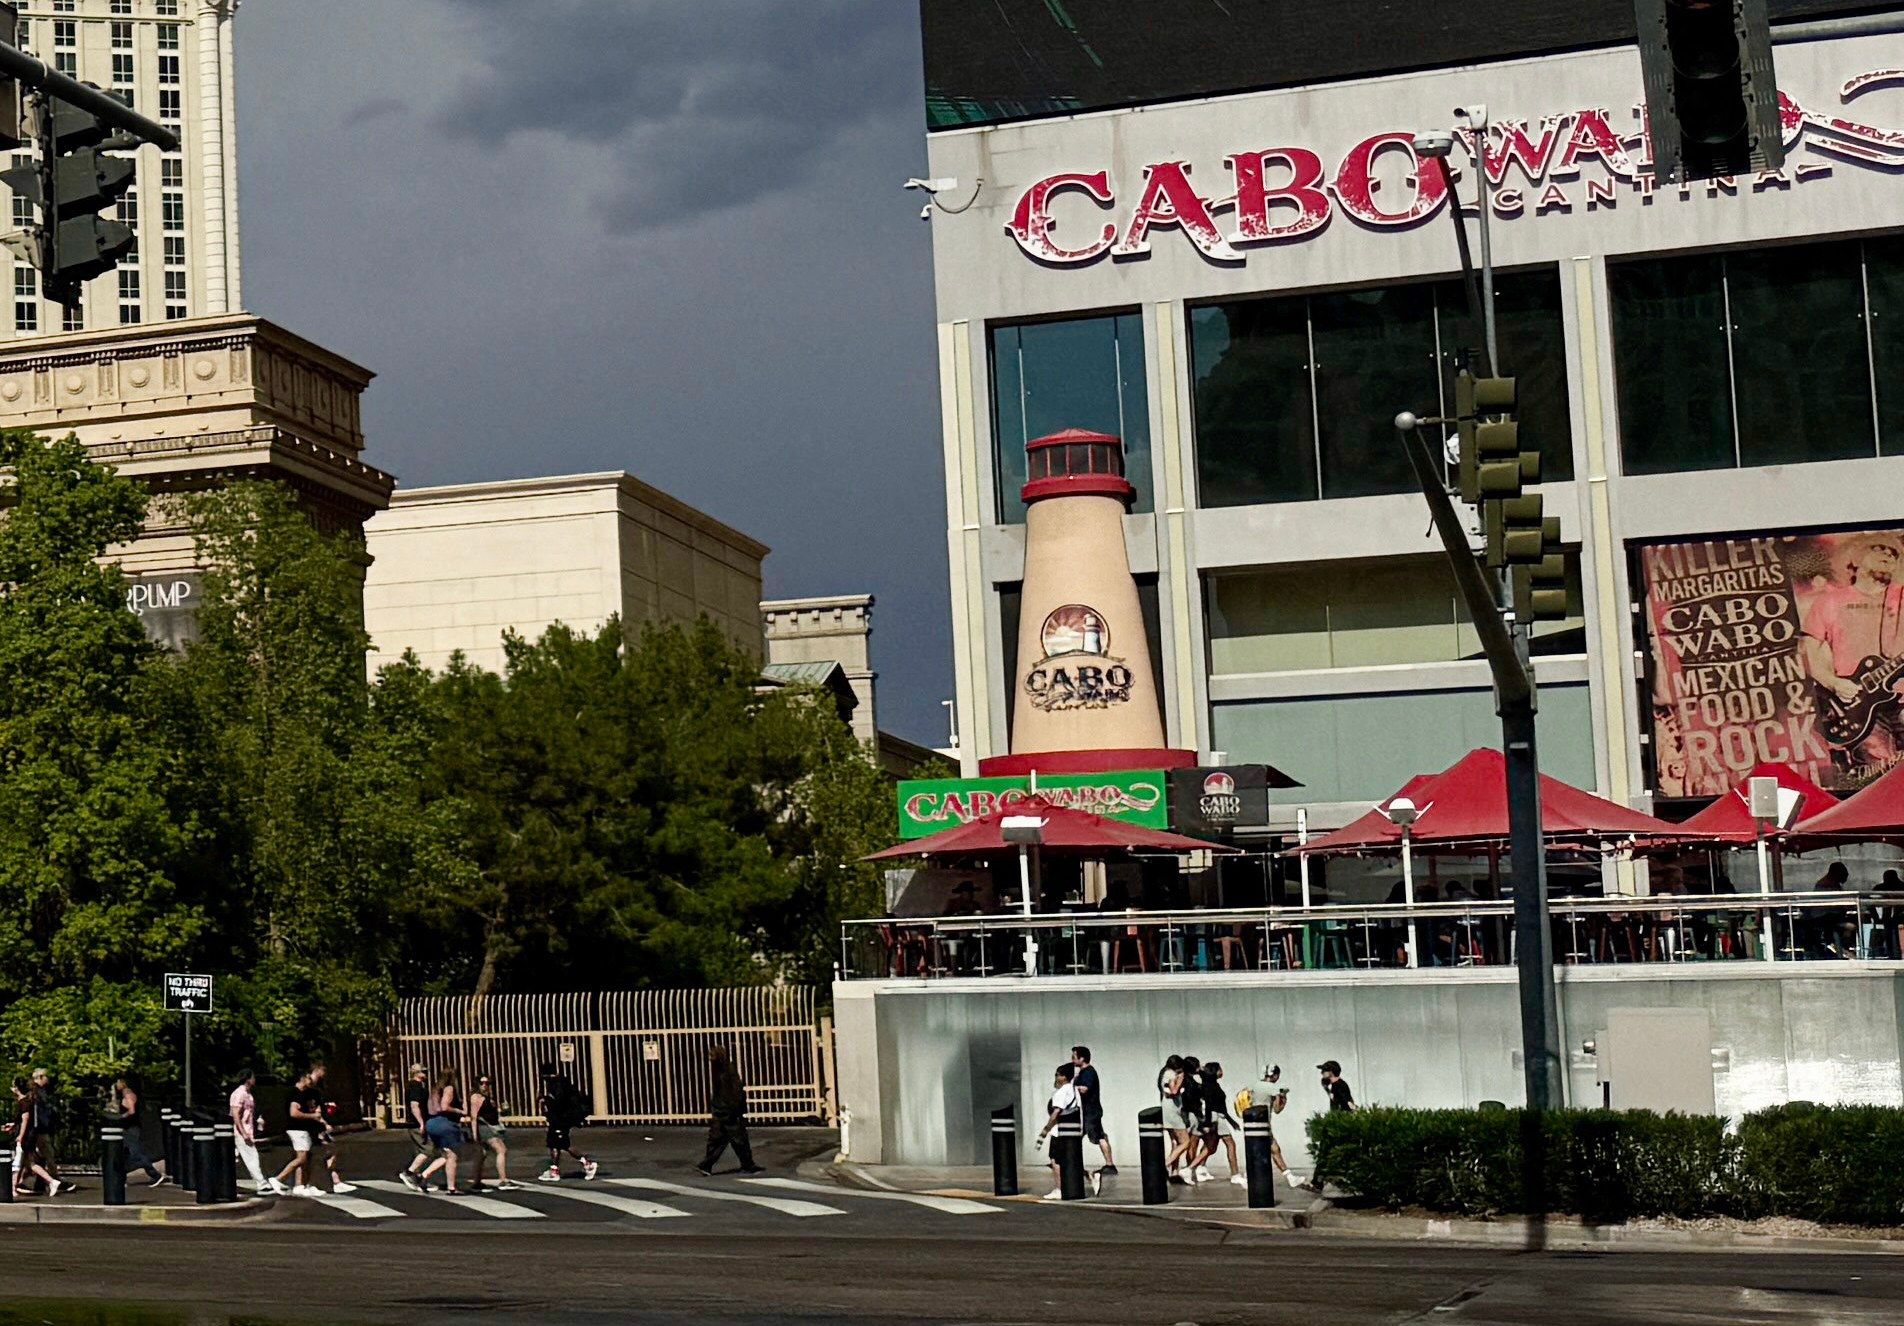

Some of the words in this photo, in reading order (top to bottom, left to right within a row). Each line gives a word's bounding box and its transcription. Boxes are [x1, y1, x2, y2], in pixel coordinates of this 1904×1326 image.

[1004, 131, 1462, 268] CABO
[1452, 89, 1806, 185] WA
[1645, 536, 1781, 582] KILLER
[1654, 563, 1786, 602] MARGARITAS
[1661, 593, 1789, 632] CABO
[1663, 619, 1796, 658] WABO
[1697, 646, 1769, 663] CANTINA
[1025, 664, 1132, 692] CABO
[1672, 651, 1808, 699] MEXICAN
[1677, 686, 1777, 730] FOOD
[1785, 681, 1816, 715] &
[1682, 712, 1828, 774] ROCK
[906, 785, 1030, 823] CABO
[168, 976, 182, 987] NO
[170, 986, 209, 998] TRAFFIC
